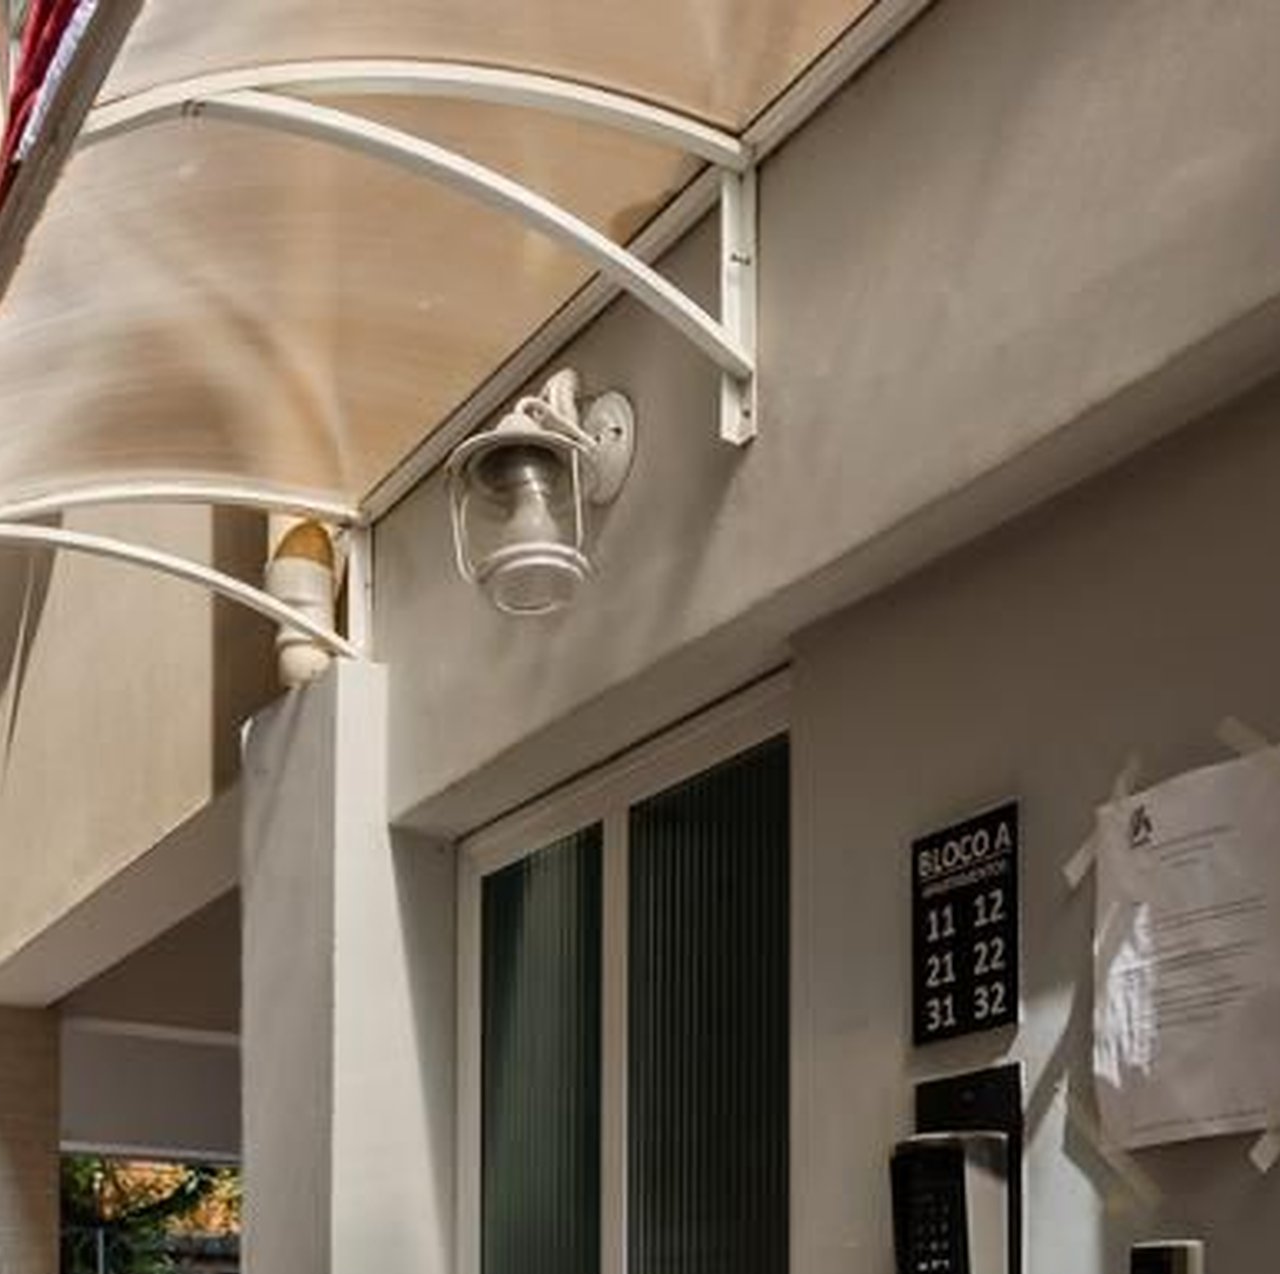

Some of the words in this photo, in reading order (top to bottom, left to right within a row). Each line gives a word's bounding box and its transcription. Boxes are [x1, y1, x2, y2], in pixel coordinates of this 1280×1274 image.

[919, 830, 989, 878] BLOCO
[994, 822, 1011, 851] A
[927, 904, 956, 943] 11
[974, 889, 1004, 927] 12
[926, 952, 956, 987] 21
[974, 937, 1005, 975] 22
[926, 994, 956, 1031] 31
[974, 981, 1006, 1019] 32
